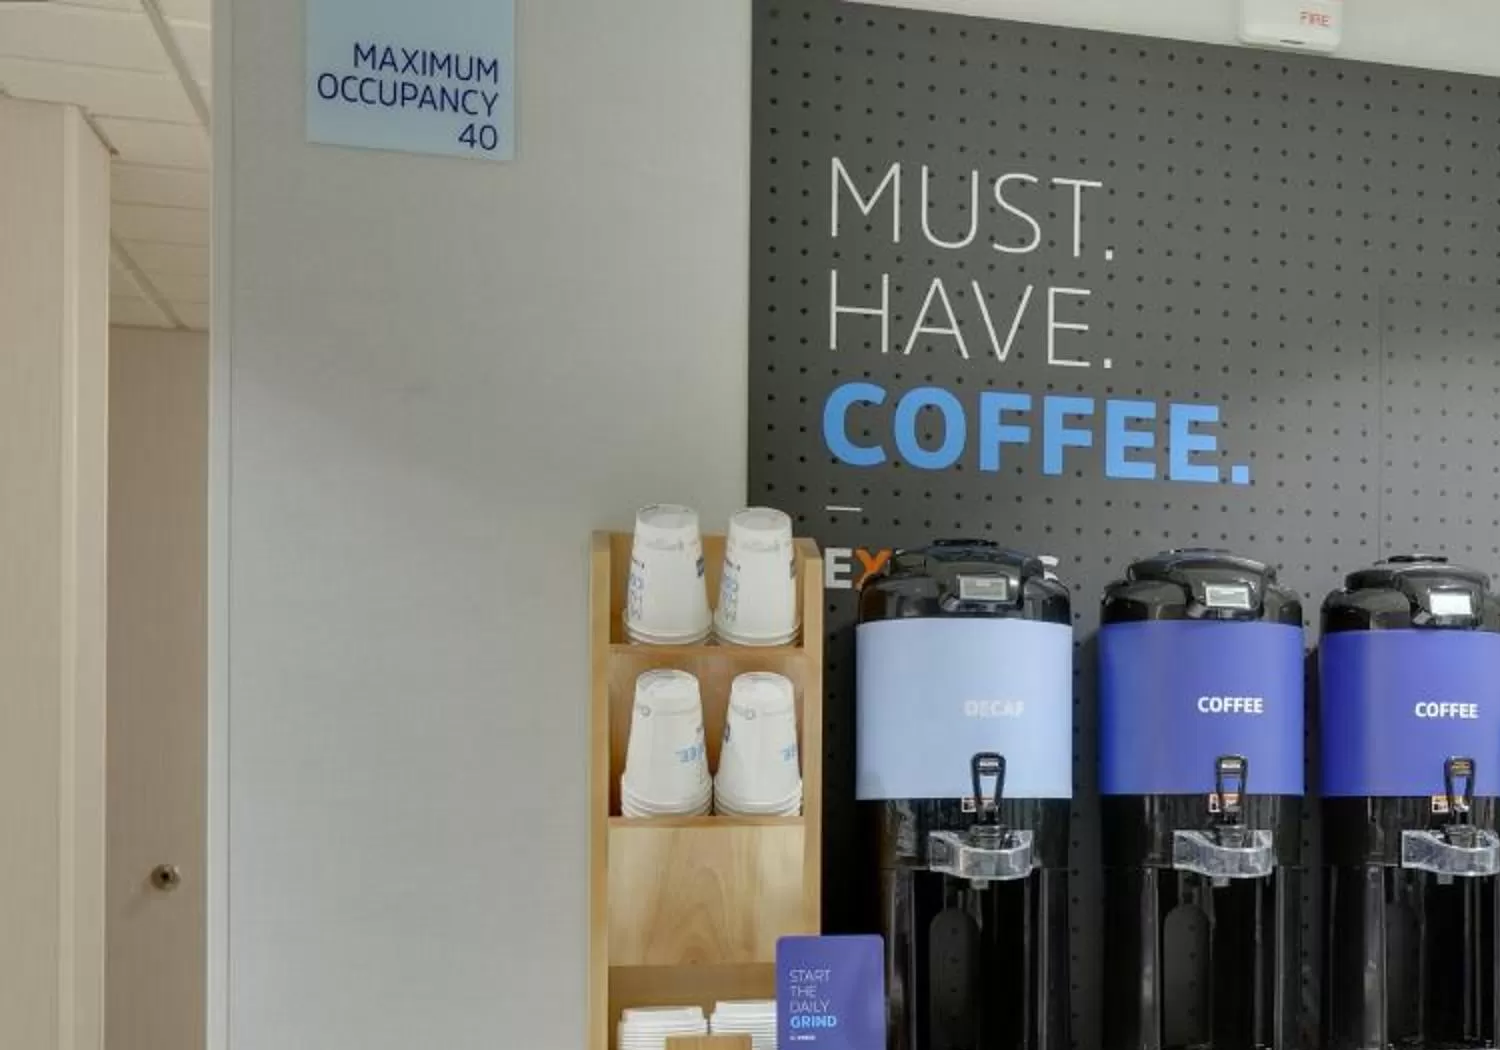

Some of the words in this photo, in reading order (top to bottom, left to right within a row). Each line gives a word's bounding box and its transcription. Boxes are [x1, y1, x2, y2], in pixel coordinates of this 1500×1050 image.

[353, 42, 499, 85] MAXIMUM
[317, 73, 499, 117] OCCUPANCY
[458, 123, 498, 151] 40
[831, 156, 1113, 260] MUST.
[829, 269, 1112, 369] HAVE.
[822, 382, 1250, 485] COFFEE.
[964, 700, 1025, 718] DECAF
[1198, 697, 1264, 713] COFFEE
[1415, 702, 1479, 719] COFFEE
[790, 969, 832, 983] START
[790, 985, 817, 998] THE
[789, 1000, 831, 1013] DAILY
[790, 1015, 837, 1029] GRIND
